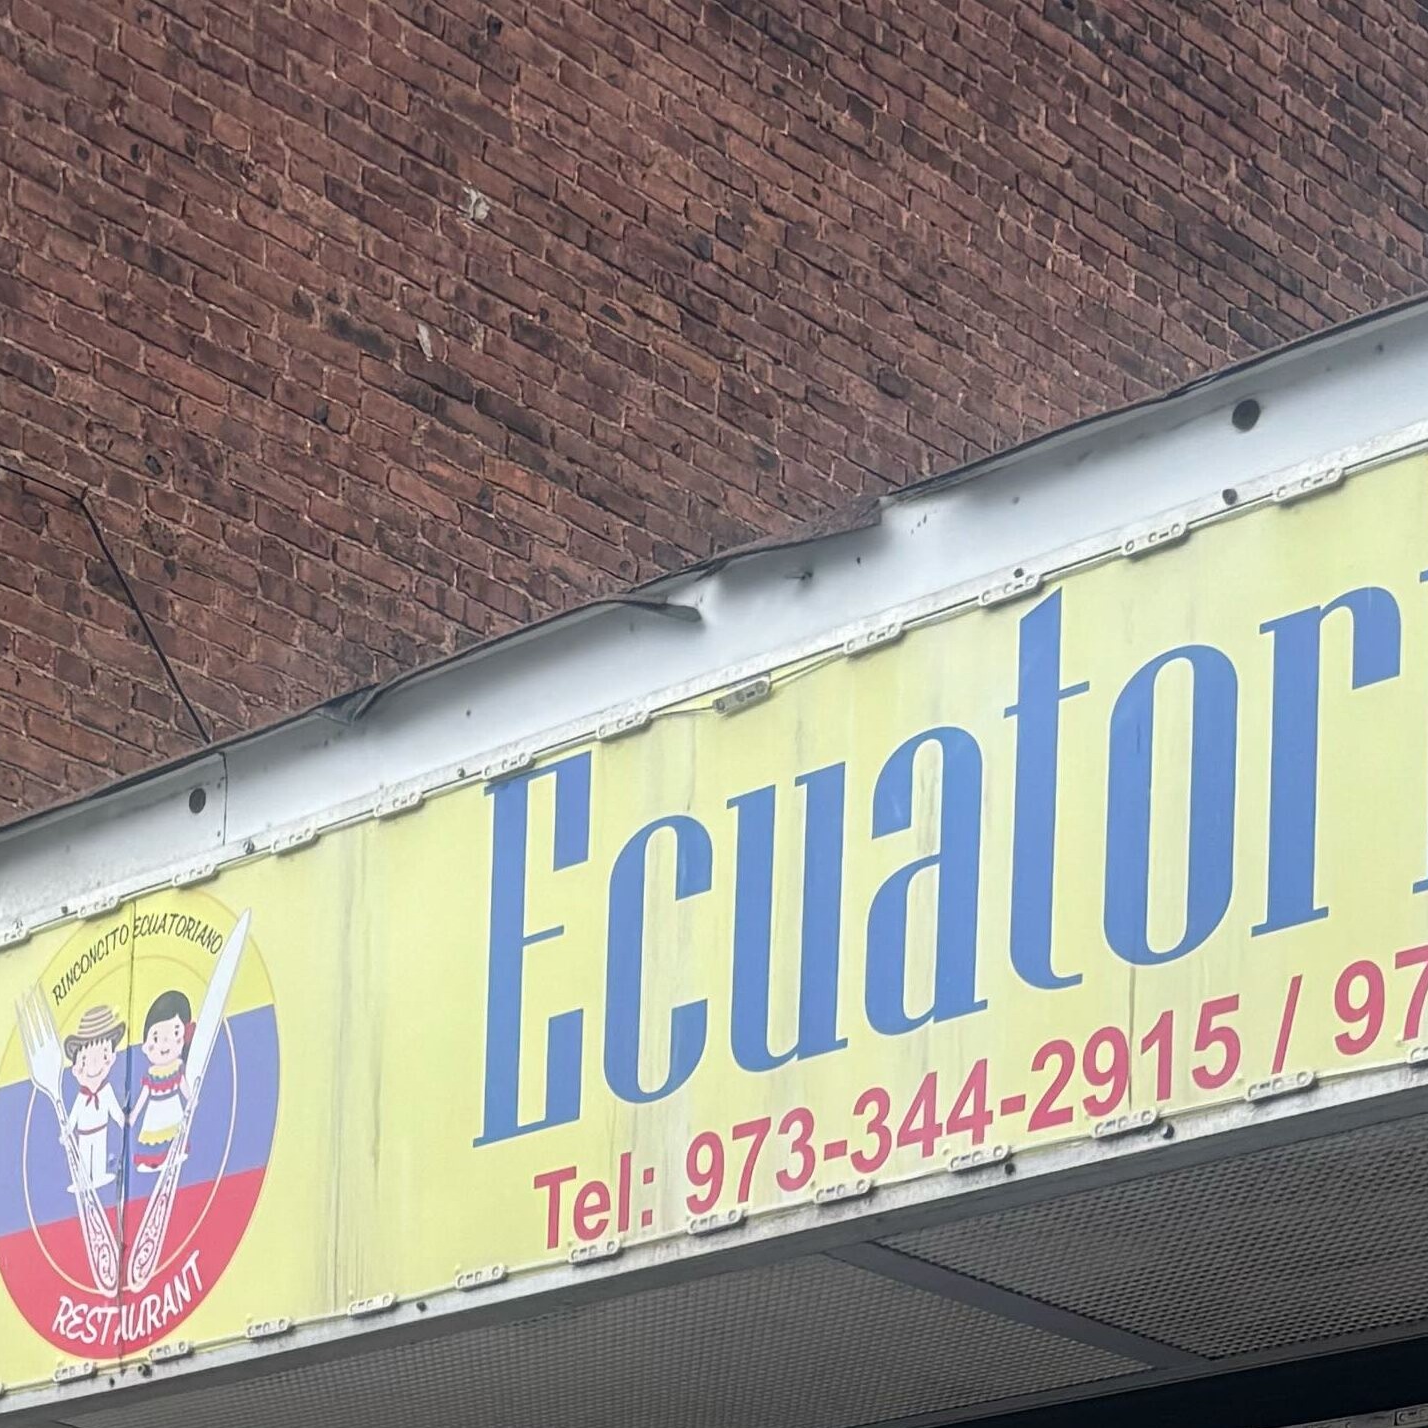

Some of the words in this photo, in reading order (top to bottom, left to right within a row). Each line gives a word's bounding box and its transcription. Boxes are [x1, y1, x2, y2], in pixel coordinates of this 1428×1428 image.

[52, 924, 129, 1006] RINCONCITO
[133, 913, 223, 955] ECUATORIANO
[534, 1159, 655, 1251] Tel:
[683, 992, 1243, 1219] 973-344-2915
[52, 1250, 204, 1347] RESTAURANT
